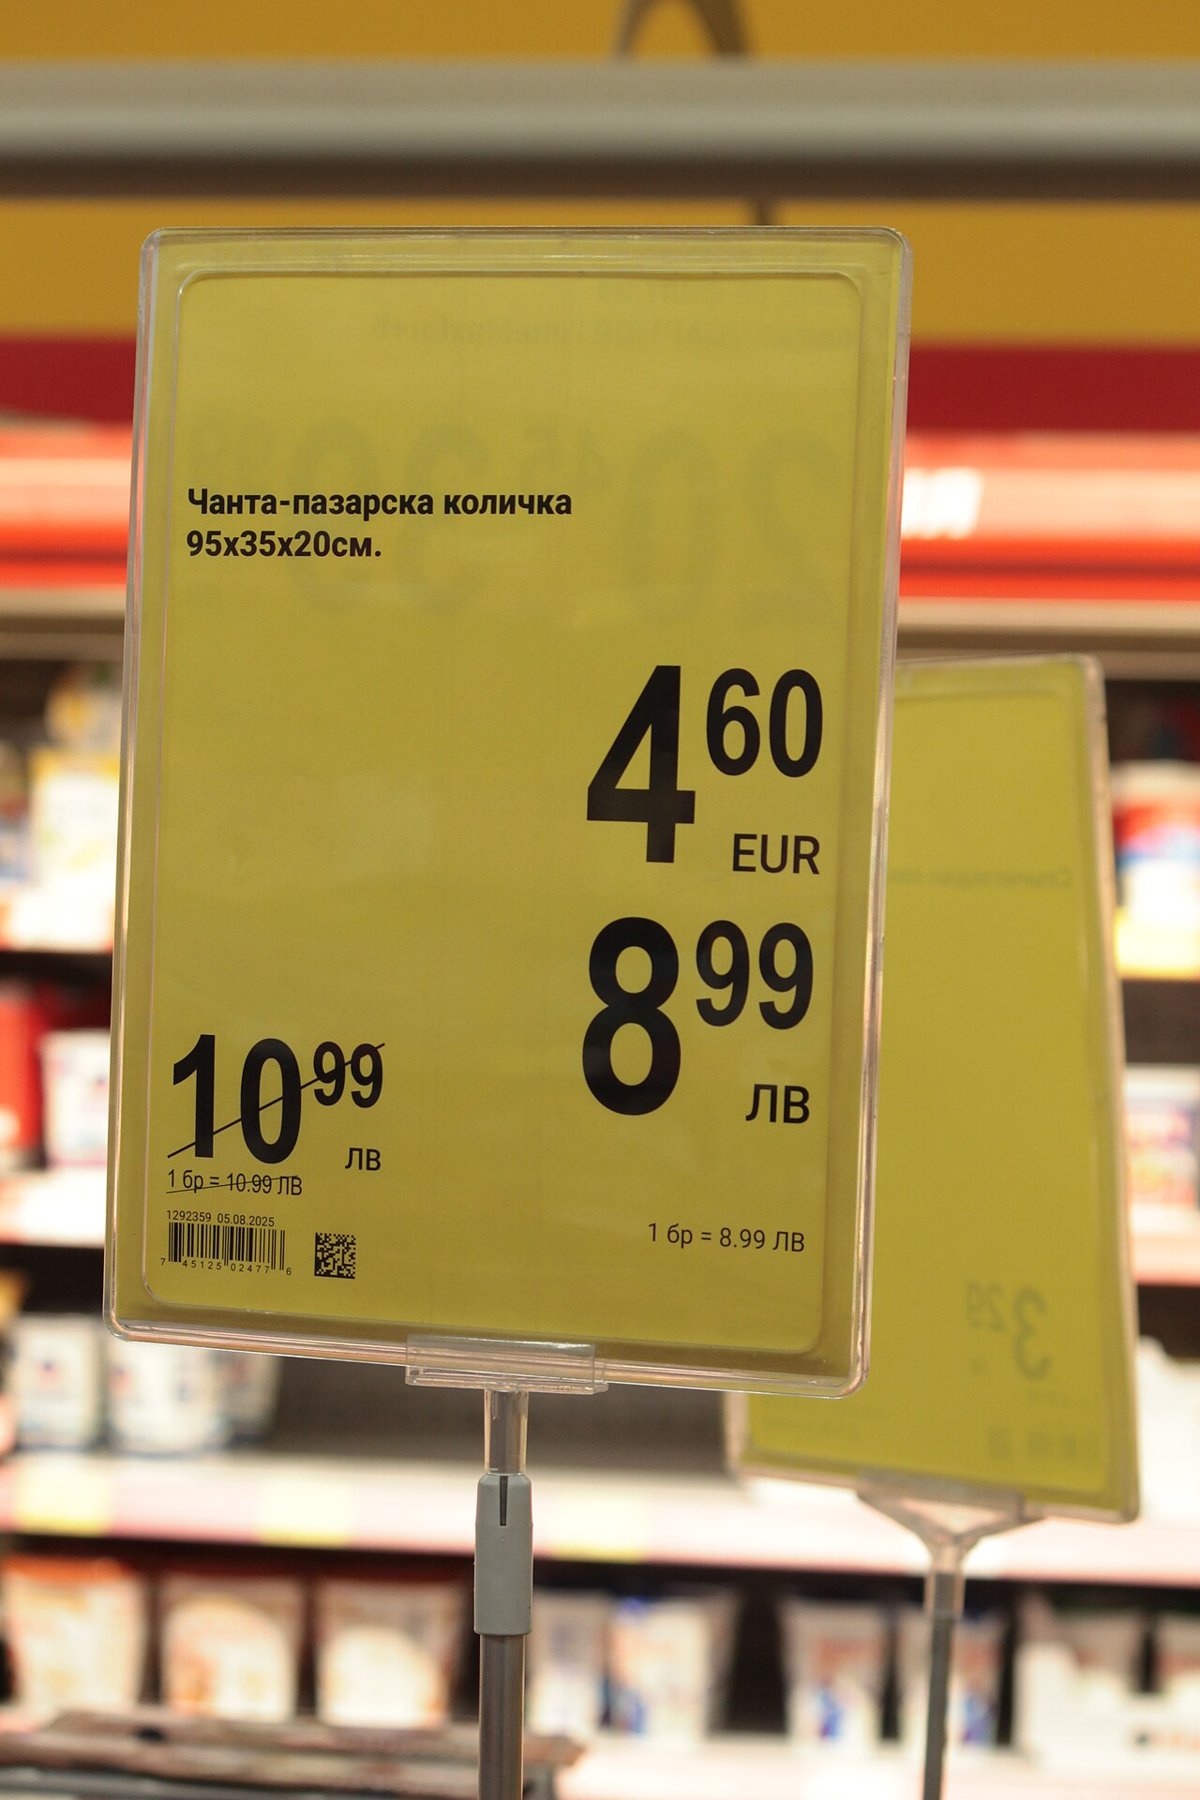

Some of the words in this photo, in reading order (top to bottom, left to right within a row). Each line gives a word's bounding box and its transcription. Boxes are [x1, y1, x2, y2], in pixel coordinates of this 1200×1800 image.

[188, 488, 433, 522] Чанта-пазарска
[443, 494, 572, 515] количка
[732, 833, 820, 875] EUR
[745, 1083, 810, 1125] ЛВ
[344, 1147, 382, 1172] ЛВ
[167, 1169, 175, 1188] 1
[182, 1169, 205, 1194] бр
[209, 1176, 220, 1188] =
[226, 1173, 273, 1195] 10.99
[276, 1175, 303, 1196] ЛВ
[167, 1209, 212, 1224] 1292359
[216, 1212, 275, 1228] 05.08.2025
[648, 1222, 657, 1242] 1
[667, 1222, 693, 1249] бр
[700, 1231, 712, 1241] =
[719, 1227, 766, 1250] 8.99
[772, 1231, 805, 1253] ЛВ
